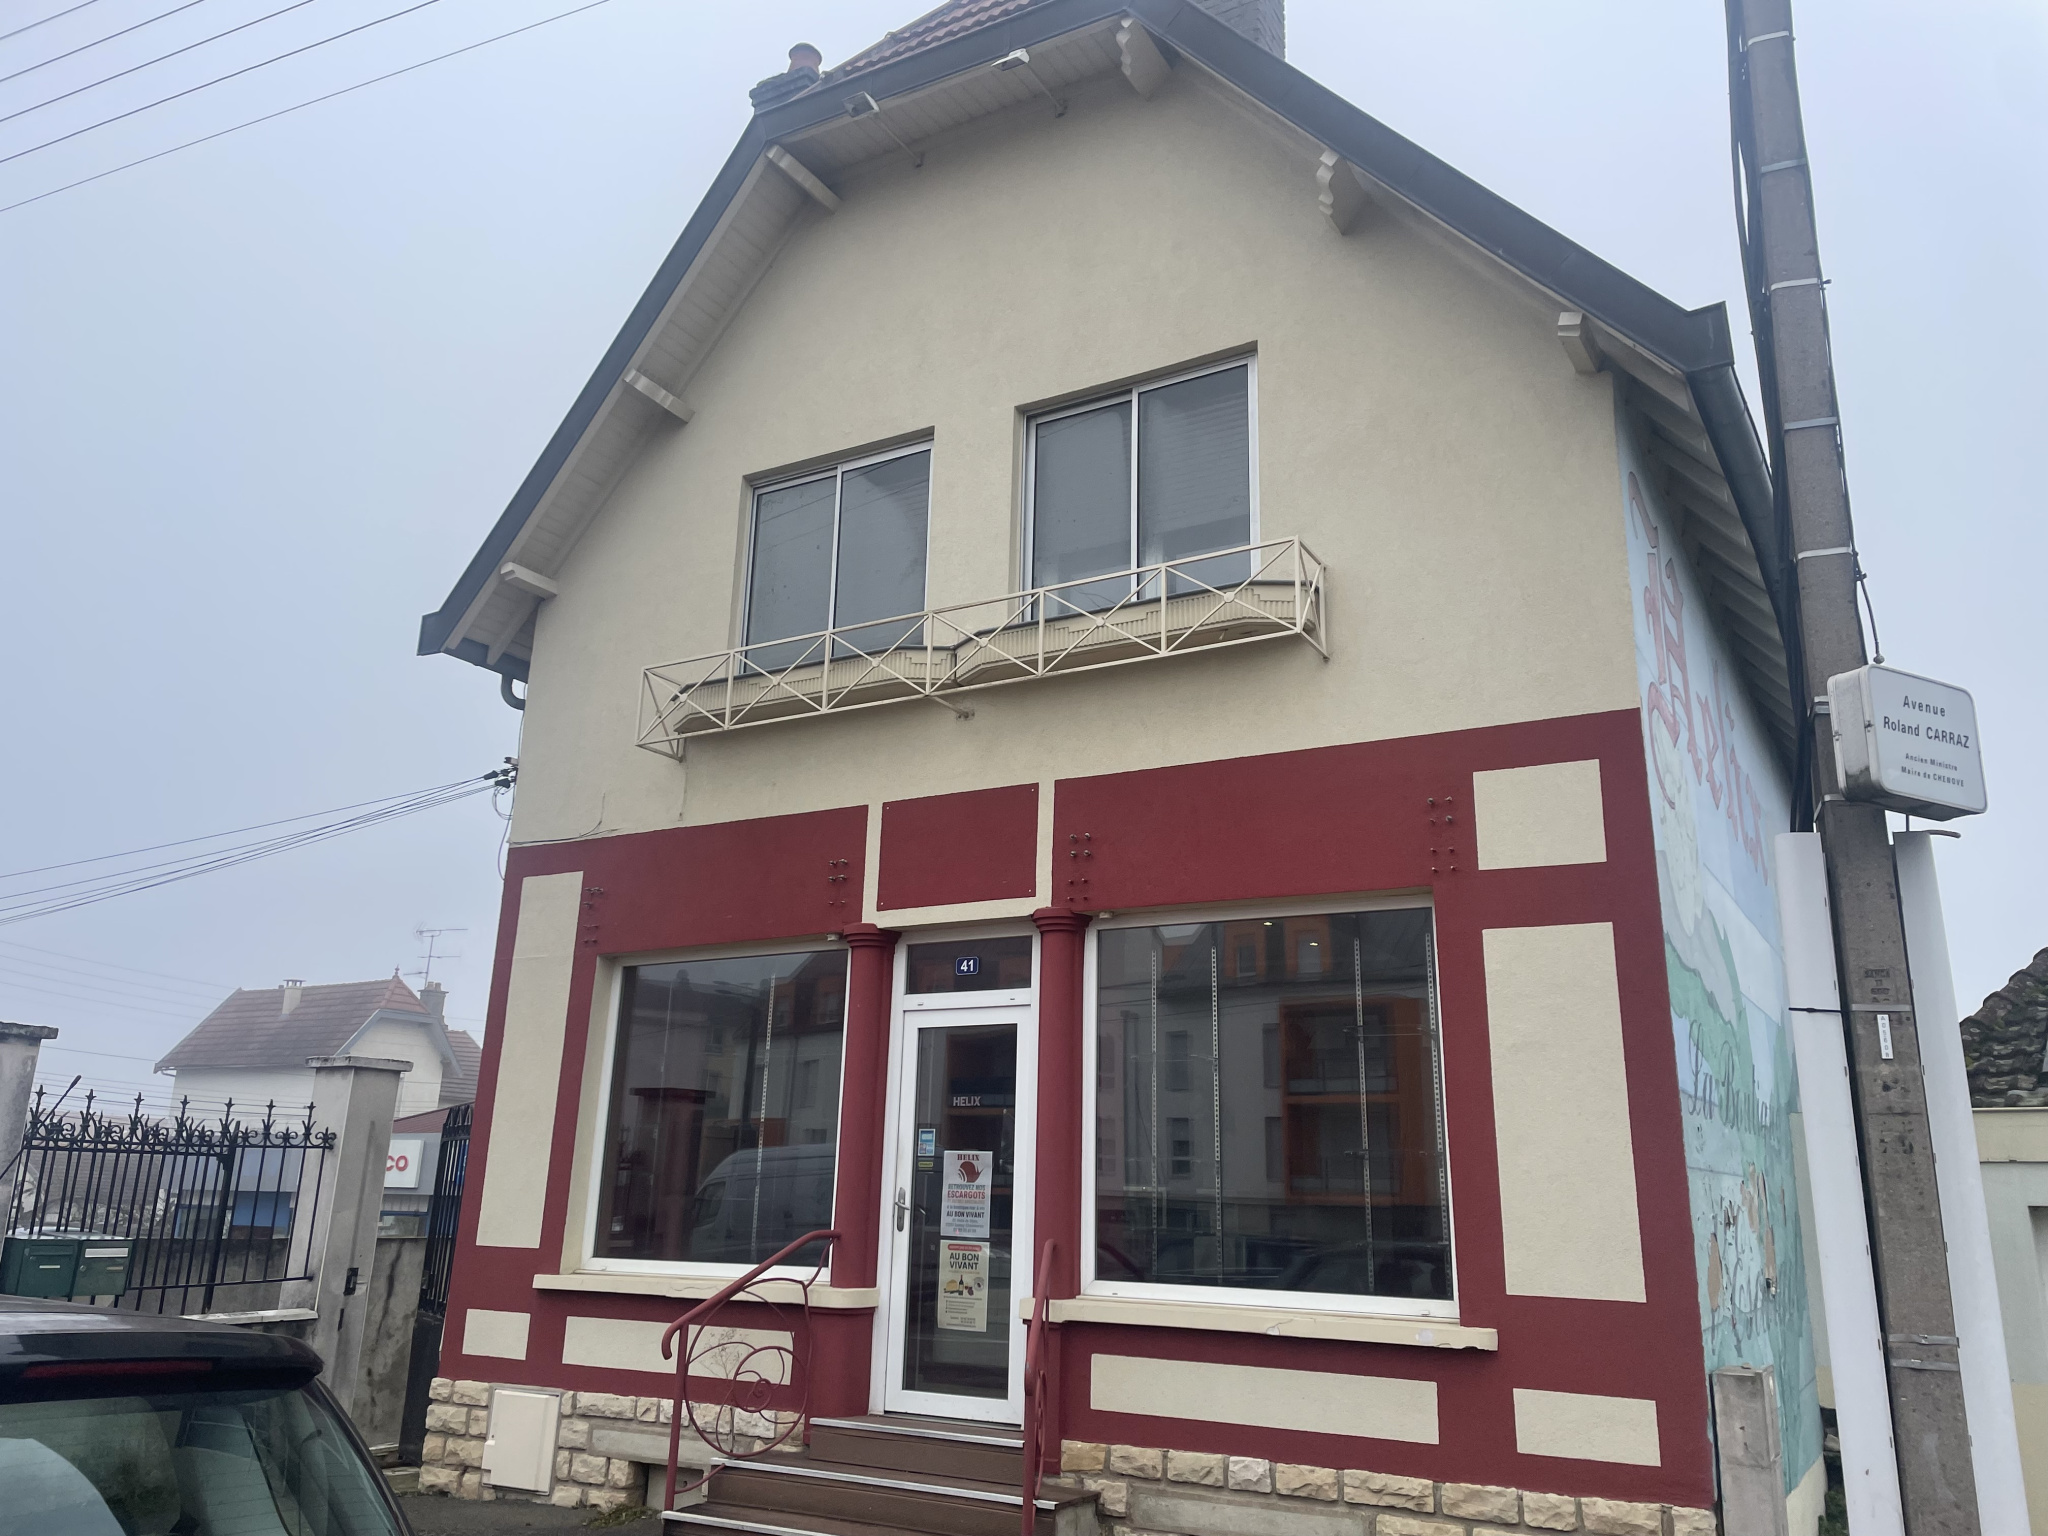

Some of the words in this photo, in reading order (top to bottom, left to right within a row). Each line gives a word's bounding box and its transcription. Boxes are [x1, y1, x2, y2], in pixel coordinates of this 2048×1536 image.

[1903, 695, 1946, 717] Avenue
[1883, 716, 1920, 737] Roland
[1926, 726, 1970, 749] CARRAZ
[1905, 753, 1928, 765] Ancien
[1930, 758, 1958, 772] Ministre
[1901, 766, 1921, 777] Maire
[1923, 771, 1931, 780] de
[960, 959, 974, 972] 41
[953, 1095, 981, 1107] HELIX
[957, 1153, 980, 1162] HELIX
[947, 1190, 986, 1199] ESCARGOTS
[949, 1252, 960, 1261] AU
[962, 1252, 980, 1262] BON
[949, 1261, 979, 1270] VIVANT
